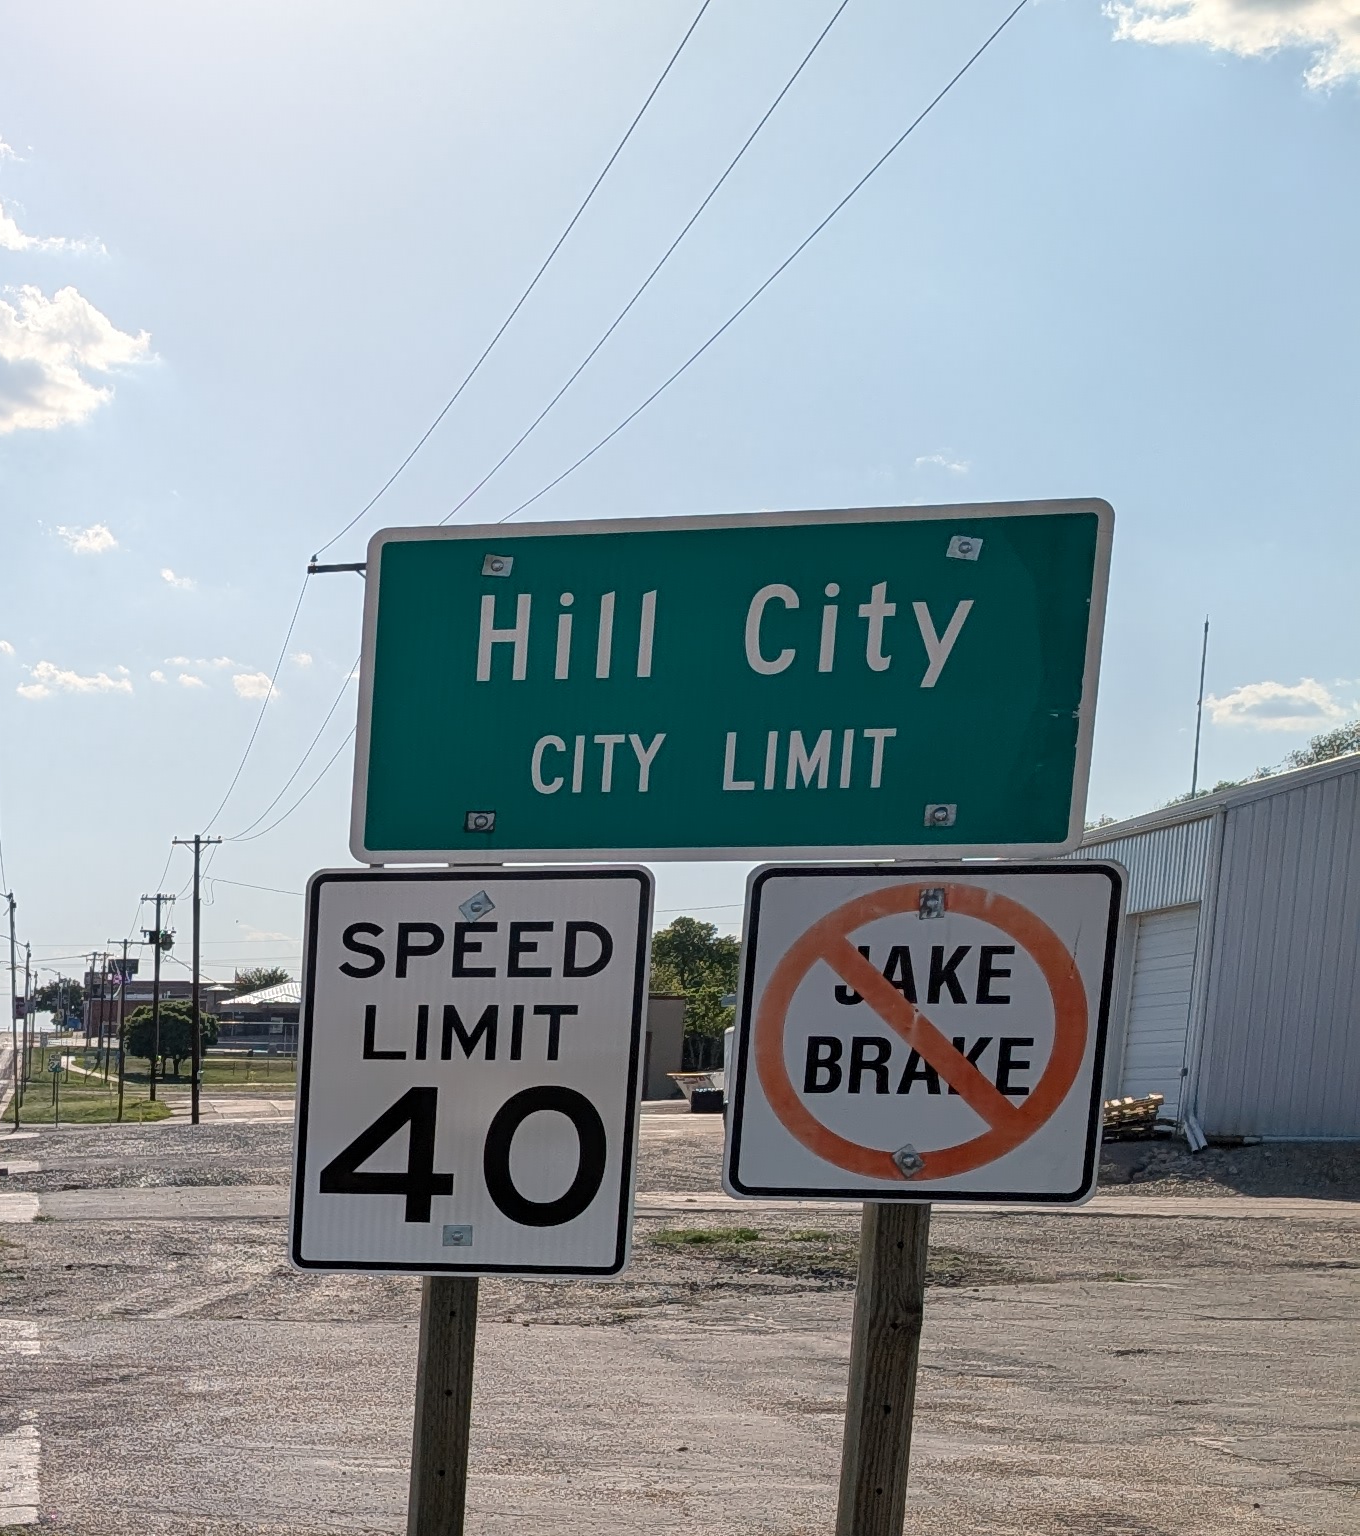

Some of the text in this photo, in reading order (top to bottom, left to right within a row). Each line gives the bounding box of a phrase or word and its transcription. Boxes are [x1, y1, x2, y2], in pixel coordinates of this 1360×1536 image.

[476, 580, 975, 688] Hill City
[530, 727, 898, 795] CITY LIMIT
[338, 921, 614, 979] SPEED
[362, 1004, 579, 1061] LIMIT
[319, 1085, 608, 1228] 40
